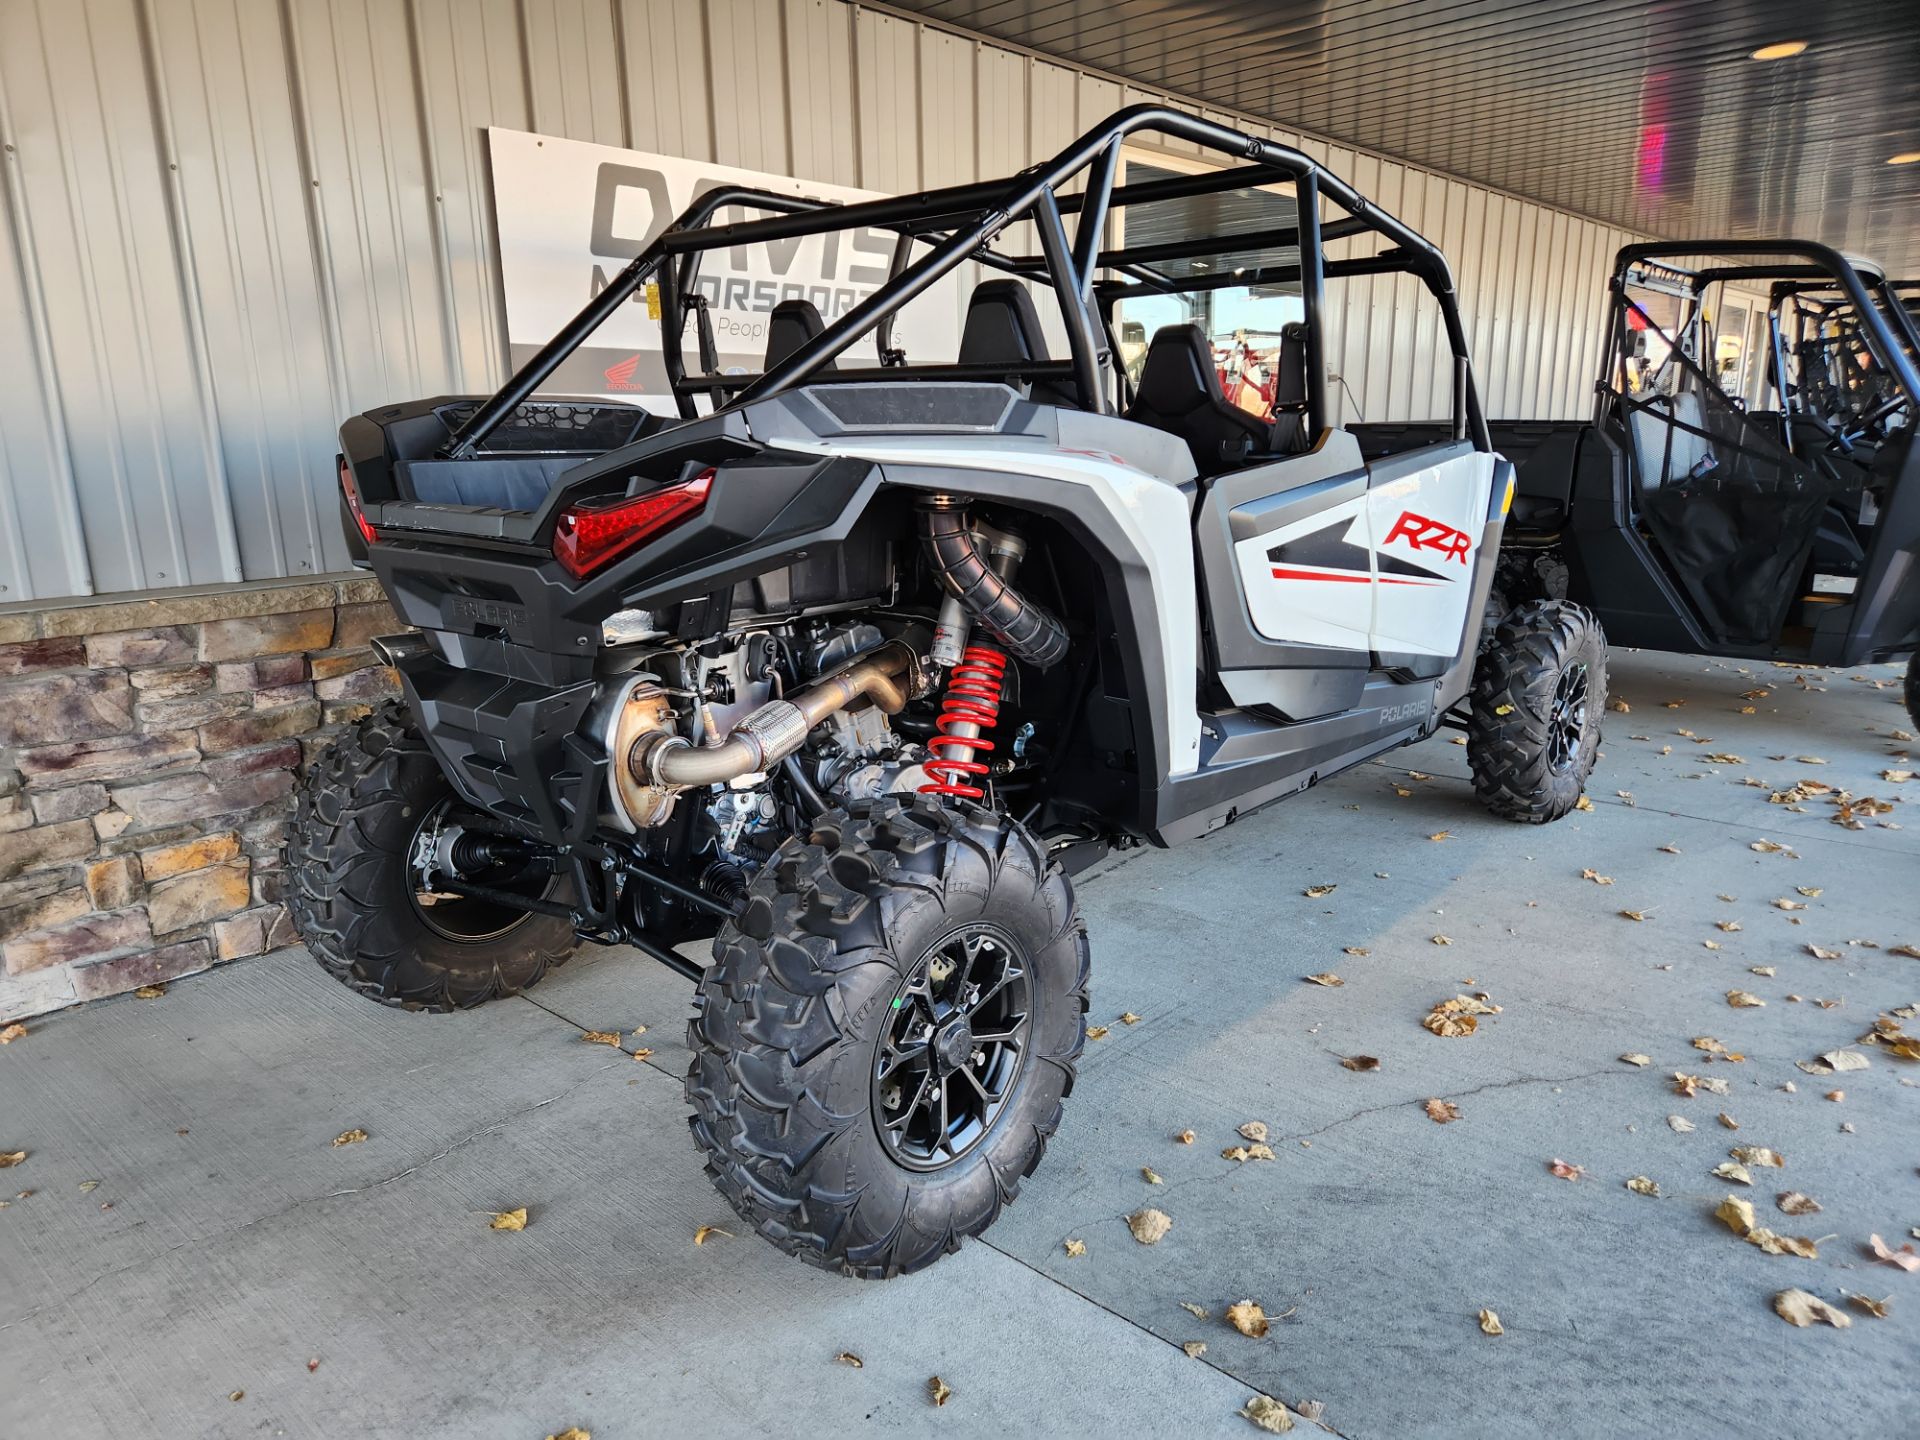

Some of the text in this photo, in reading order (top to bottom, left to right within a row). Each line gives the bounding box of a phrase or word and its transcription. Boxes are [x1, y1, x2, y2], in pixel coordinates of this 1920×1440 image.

[718, 317, 769, 341] Peopl
[607, 383, 645, 391] HONDA
[1383, 510, 1472, 565] RZR
[452, 599, 528, 627] POLARIS
[1379, 700, 1427, 725] POLARIS
